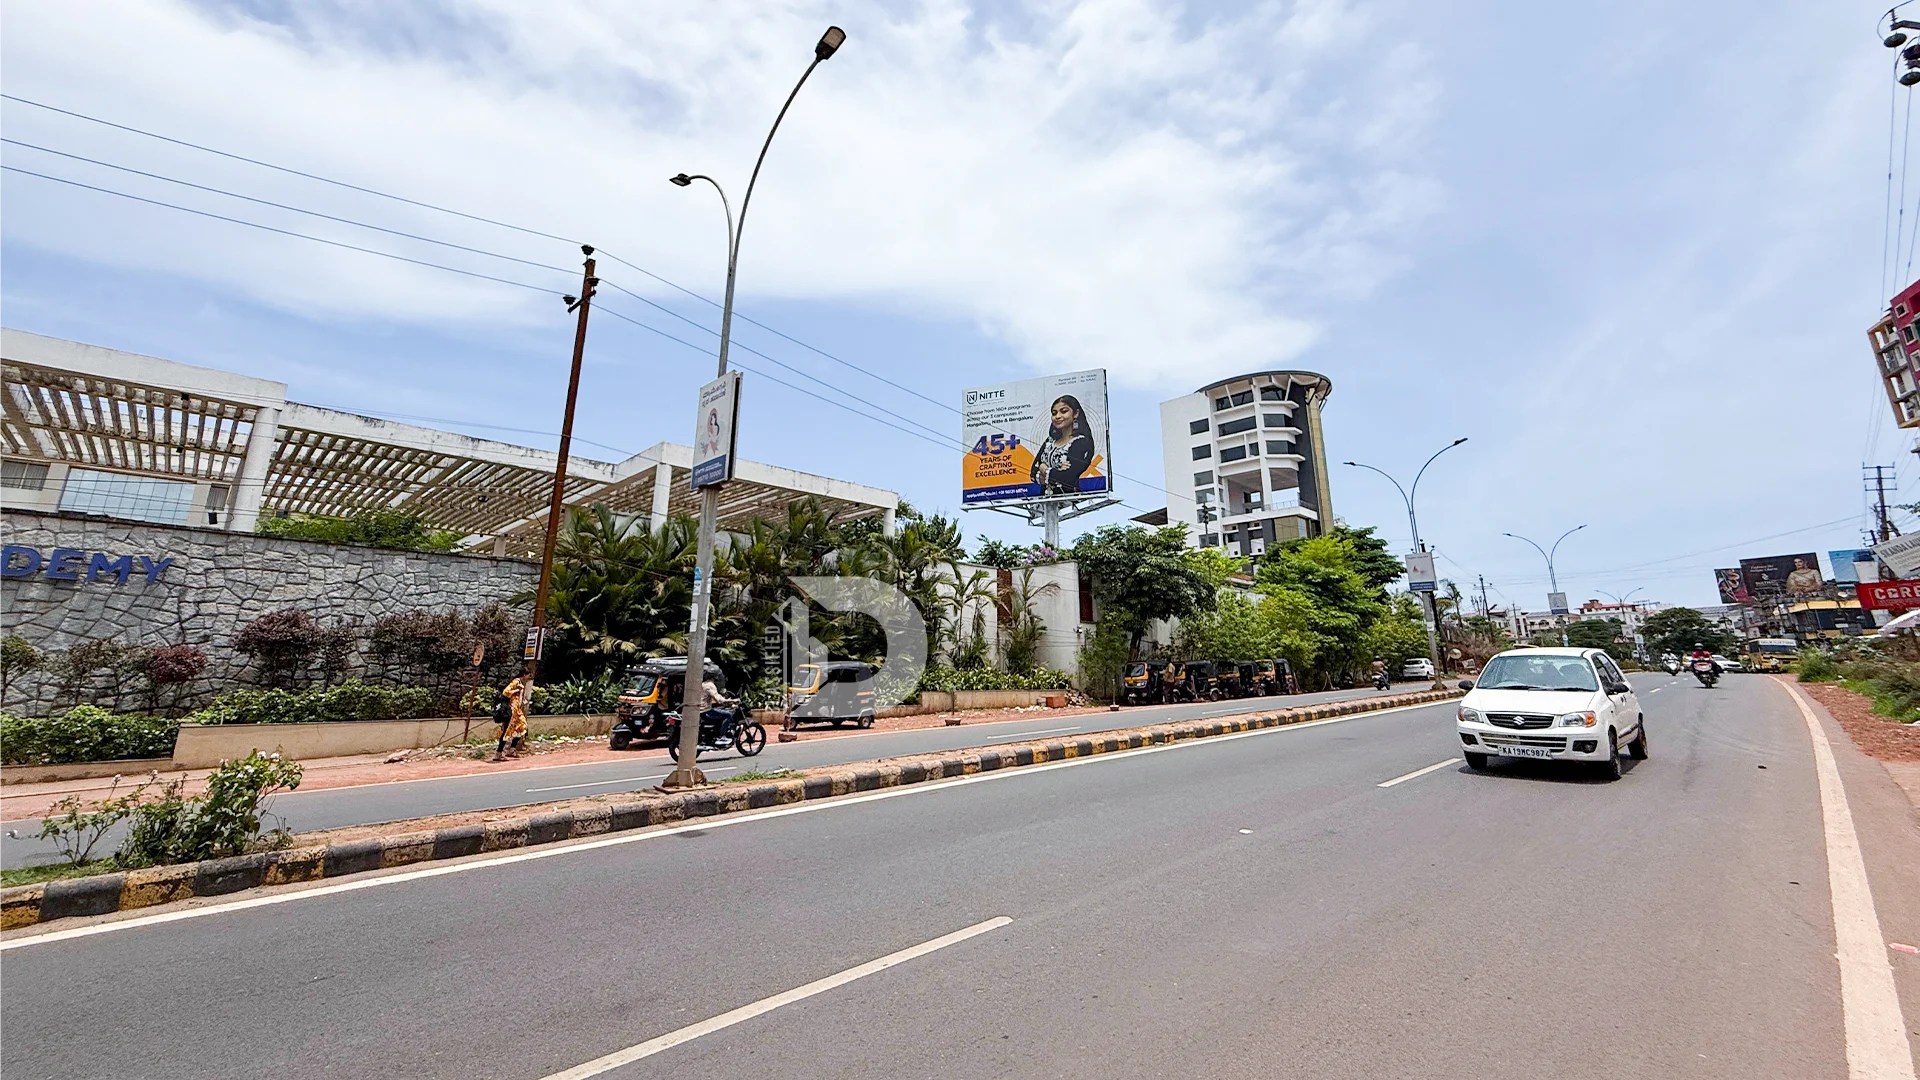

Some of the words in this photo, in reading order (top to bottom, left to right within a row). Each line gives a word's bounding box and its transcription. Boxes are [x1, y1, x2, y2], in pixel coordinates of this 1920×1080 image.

[979, 390, 1005, 400] NITTE
[966, 409, 984, 417] Choose
[1007, 403, 1031, 411] programs
[1008, 415, 1034, 423] Bengaluru
[972, 433, 1021, 456] 45+
[979, 462, 1013, 471] CRAFTING
[975, 468, 1017, 478] EXCELLENCE
[1, 543, 175, 585] DEMY
[1502, 747, 1550, 758] KA19MC9874
